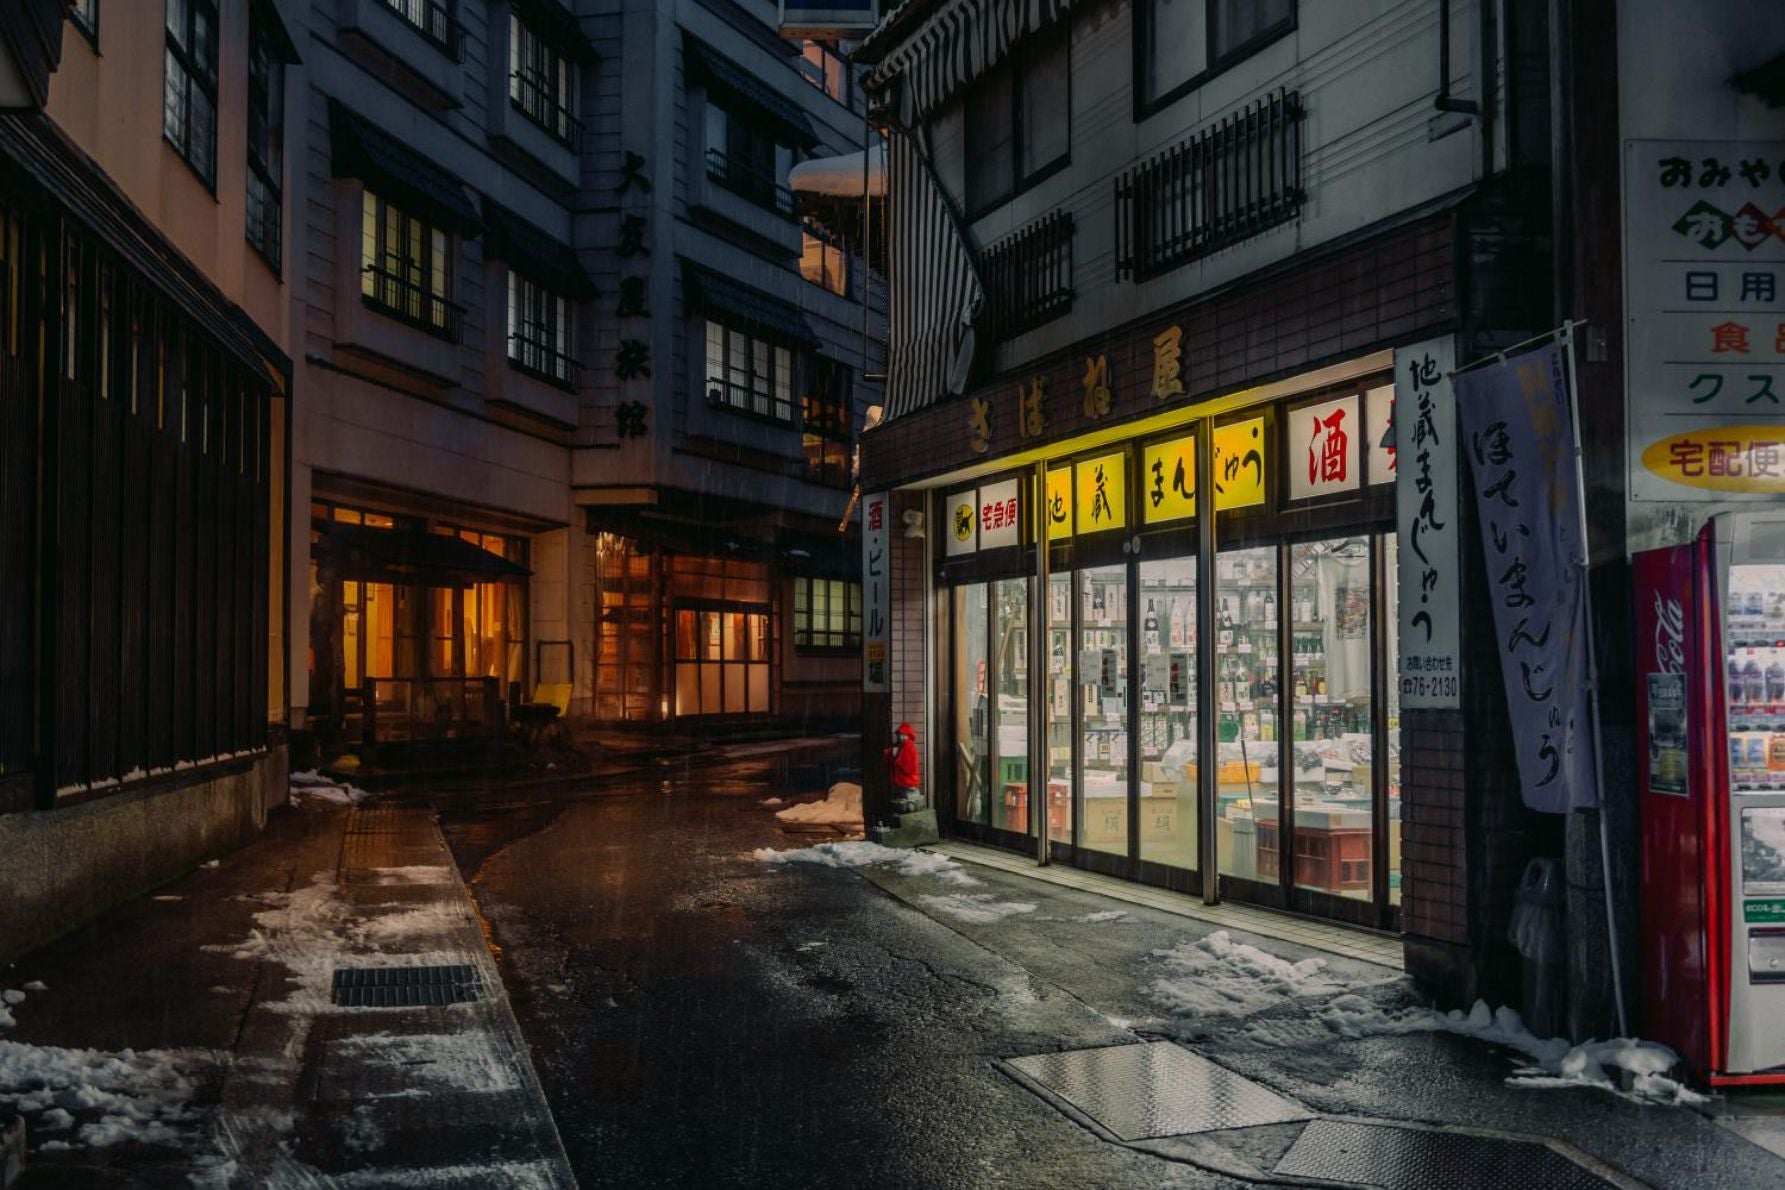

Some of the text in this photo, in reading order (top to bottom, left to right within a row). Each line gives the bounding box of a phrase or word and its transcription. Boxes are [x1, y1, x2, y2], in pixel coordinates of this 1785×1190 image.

[1658, 157, 1785, 188] おみや
[1686, 271, 1775, 302] 日用
[1690, 373, 1779, 404] クス
[1308, 408, 1348, 486] 酒
[982, 498, 1017, 532] 宅急便
